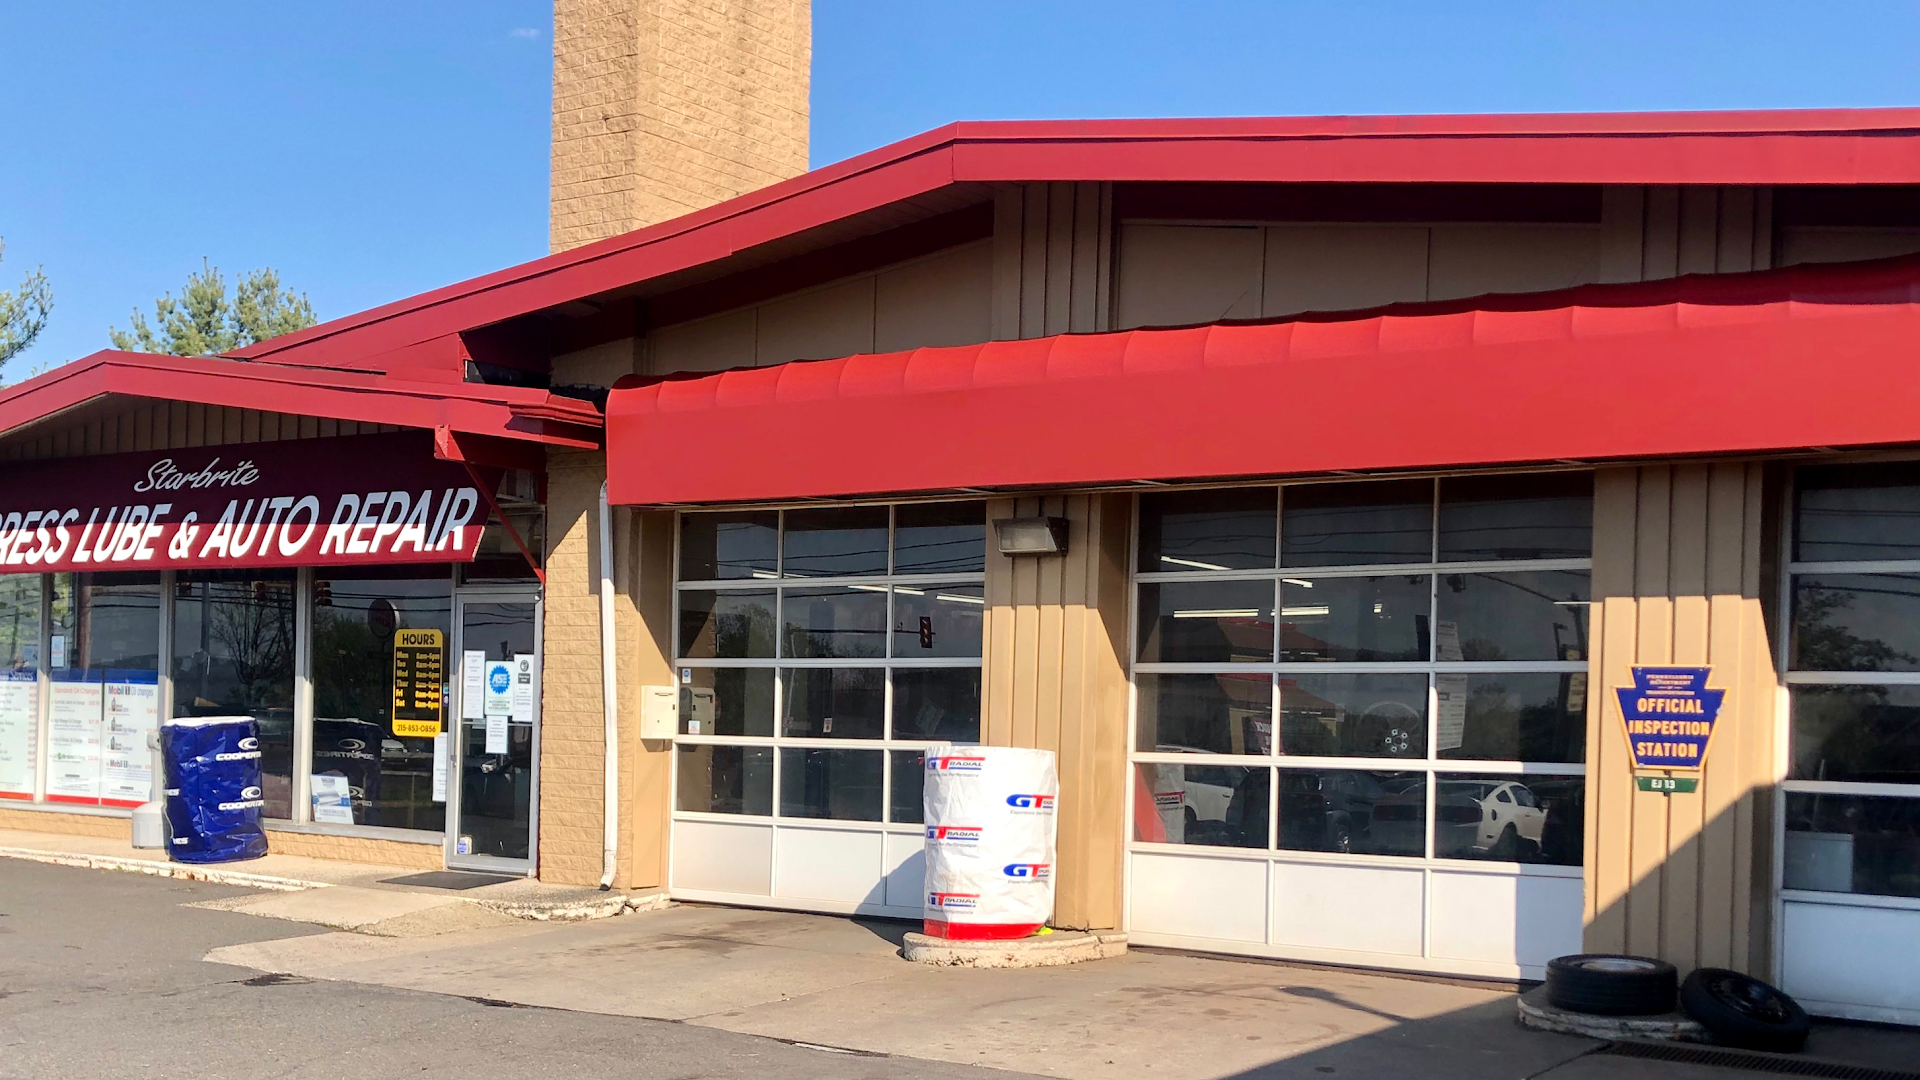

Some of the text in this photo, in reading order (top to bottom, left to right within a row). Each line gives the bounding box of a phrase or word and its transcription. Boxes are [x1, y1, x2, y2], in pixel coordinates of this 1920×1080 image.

[134, 457, 260, 492] Starbrite
[0, 487, 479, 565] RESS LUBE & AUTO REPAIR
[402, 633, 436, 645] HOURS
[491, 673, 508, 683] ASE
[108, 685, 124, 695] Mobil
[1637, 698, 1705, 714] OFFICIAL
[396, 724, 437, 733] 215-853-0856
[1628, 720, 1710, 736] INSPECTION
[1637, 742, 1698, 758] STATION
[1664, 780, 1676, 789] 13
[1005, 794, 1050, 808] GT
[1003, 864, 1046, 877] GT
